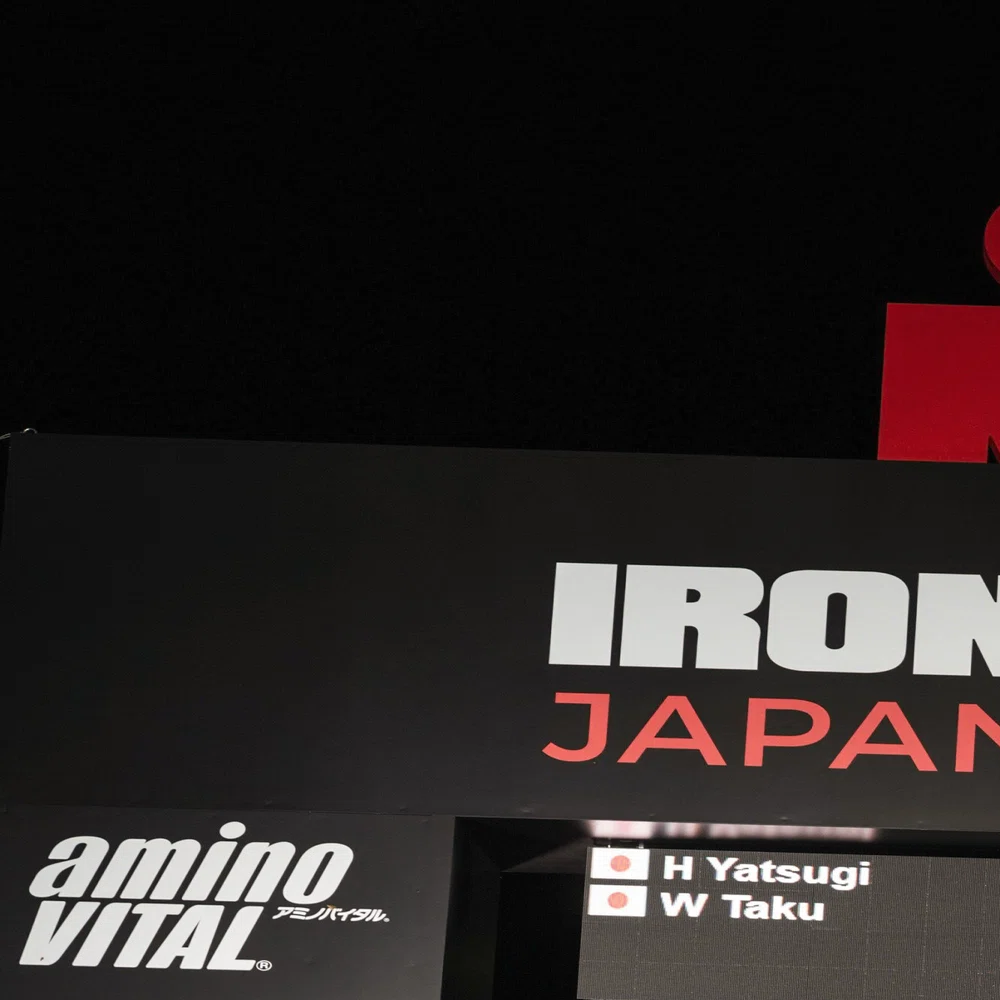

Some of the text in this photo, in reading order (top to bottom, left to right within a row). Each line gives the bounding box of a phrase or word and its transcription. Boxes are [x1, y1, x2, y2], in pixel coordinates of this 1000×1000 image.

[28, 821, 354, 905] amino
[663, 855, 694, 880] H
[706, 856, 871, 891] Yatsugi
[660, 892, 709, 918] W
[721, 894, 825, 922] Taku
[19, 900, 264, 971] VITAL
